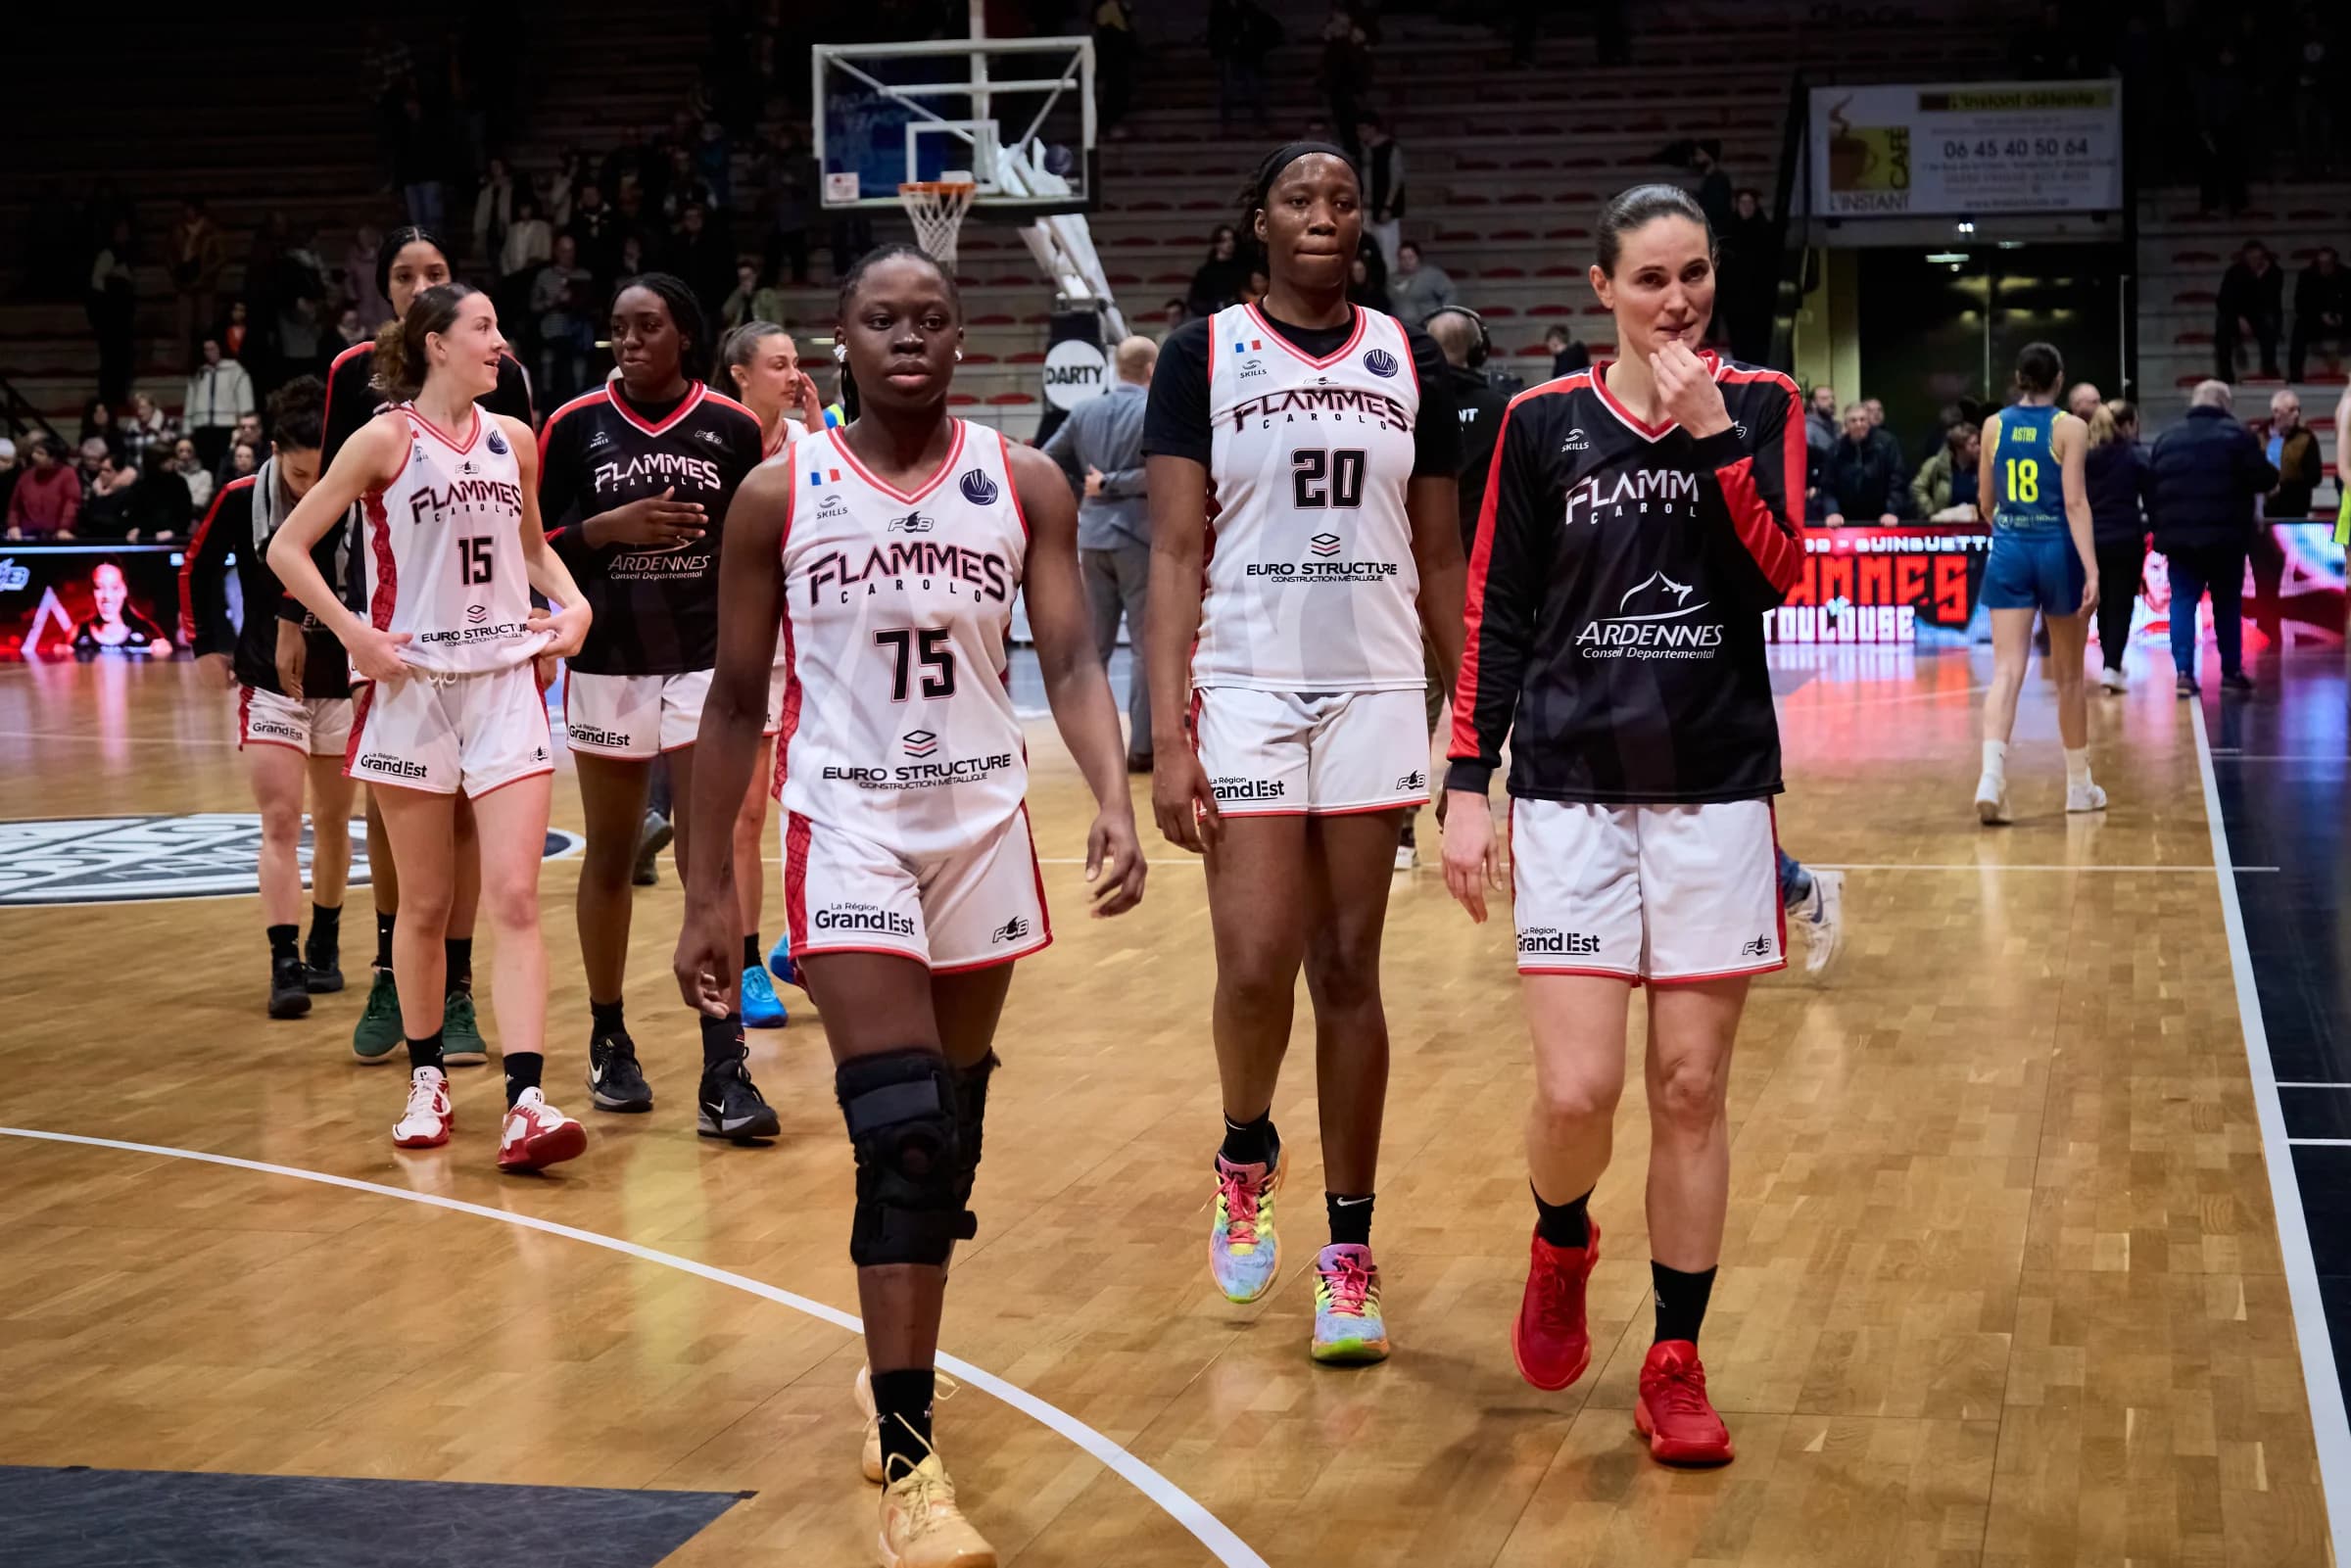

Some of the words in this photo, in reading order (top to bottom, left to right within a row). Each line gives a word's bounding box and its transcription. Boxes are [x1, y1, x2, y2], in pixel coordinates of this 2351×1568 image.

[1943, 140, 1968, 159] 06
[1975, 140, 1998, 158] 45
[2004, 139, 2028, 157] 40
[2035, 138, 2058, 156] 50
[2065, 138, 2088, 155] 64
[1045, 365, 1103, 385] DARTY
[1240, 368, 1267, 379] SKILLS
[1233, 390, 1409, 433] FLAMMES
[1263, 413, 1387, 430] CAROLO
[1561, 442, 1589, 452] SKILLS
[595, 453, 722, 494] FLAMMES
[613, 475, 704, 492] CAROLO
[1291, 448, 1367, 509] 20
[2006, 457, 2039, 503] 18
[408, 480, 523, 525] FLAMMES
[1565, 469, 1700, 525] FLAMM
[434, 502, 513, 522] CAROLO
[816, 506, 848, 520] SKILLS
[1591, 502, 1697, 524] CAROL
[457, 536, 494, 586] 15
[607, 554, 711, 572] ARDENNES
[1246, 563, 1295, 576] EURO
[1302, 562, 1397, 576] STRUCTURE
[611, 571, 640, 580] Conseil
[643, 570, 702, 581] Departemental
[806, 541, 1007, 607] FLAMMES
[840, 579, 982, 603] CAROLO
[1762, 605, 1915, 642] TOULOUSE
[421, 631, 460, 642] EURO
[1575, 621, 1724, 647] ARDENNES
[1582, 646, 1624, 658] Conseil
[1626, 647, 1715, 660] Departemental
[873, 627, 957, 702] 75
[822, 766, 888, 781] EURO
[895, 753, 1011, 781] STRUCTURE
[859, 780, 937, 790] CONSTRUCTION
[938, 772, 987, 787] MÉTALLIQUE
[1219, 776, 1247, 784] Région
[831, 902, 842, 911] La
[845, 902, 879, 912] Région
[1530, 927, 1558, 936] Région
